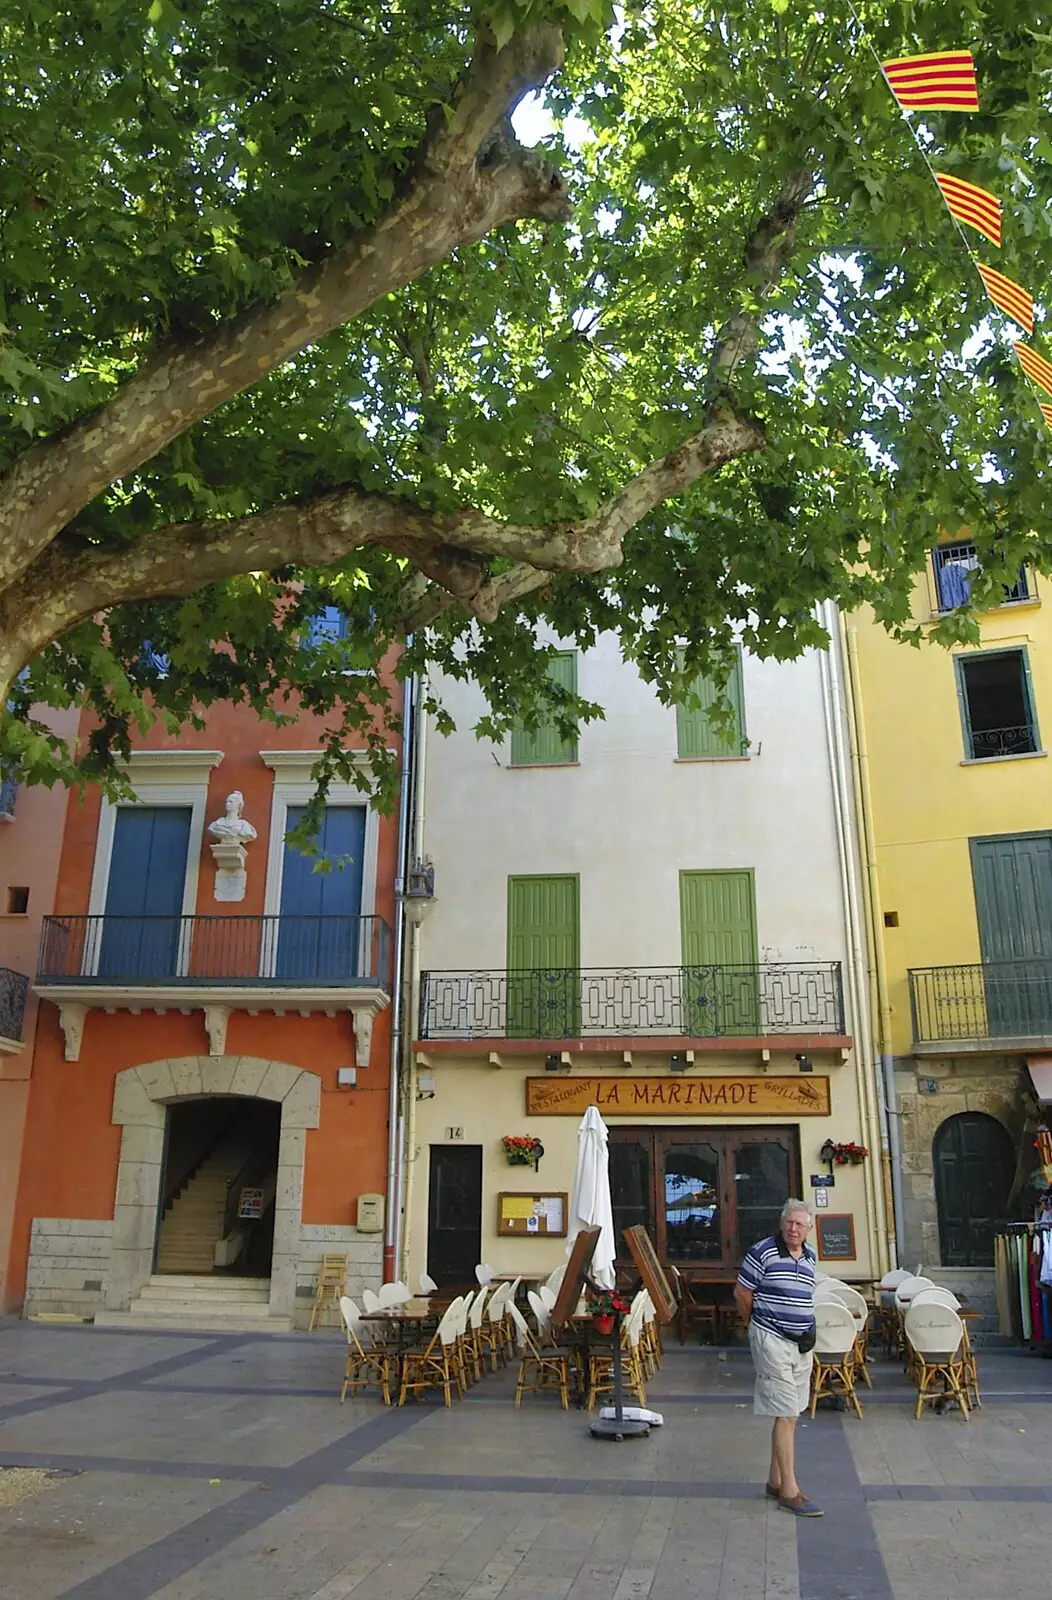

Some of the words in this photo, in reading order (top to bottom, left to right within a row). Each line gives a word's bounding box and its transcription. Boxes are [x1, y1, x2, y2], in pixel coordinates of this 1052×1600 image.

[531, 1080, 592, 1112] RESTAURANT
[595, 1082, 620, 1104] LA
[633, 1082, 759, 1104] MARINADE
[764, 1080, 821, 1111] GRILLADES
[449, 1127, 461, 1140] 14
